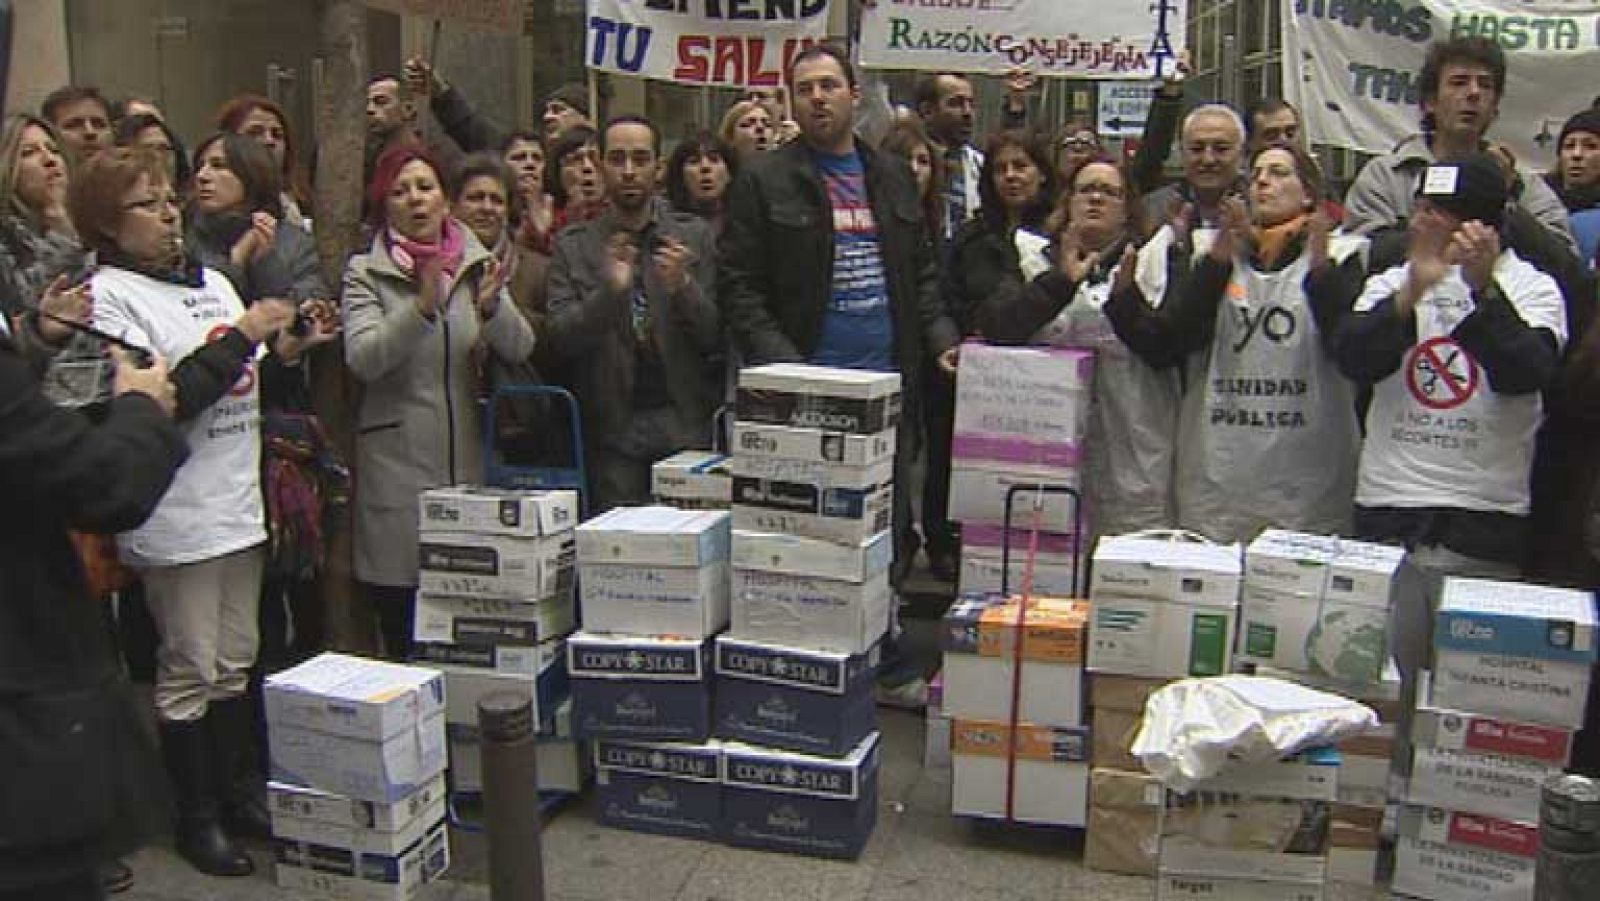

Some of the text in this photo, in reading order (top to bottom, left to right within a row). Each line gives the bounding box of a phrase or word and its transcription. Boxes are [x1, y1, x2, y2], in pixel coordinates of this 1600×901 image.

[590, 17, 652, 72] TU
[582, 653, 685, 671] COPY STAR
[728, 653, 836, 684] COPY STAR
[606, 750, 708, 775] COPY STAR
[736, 765, 842, 790] COPY STAR
